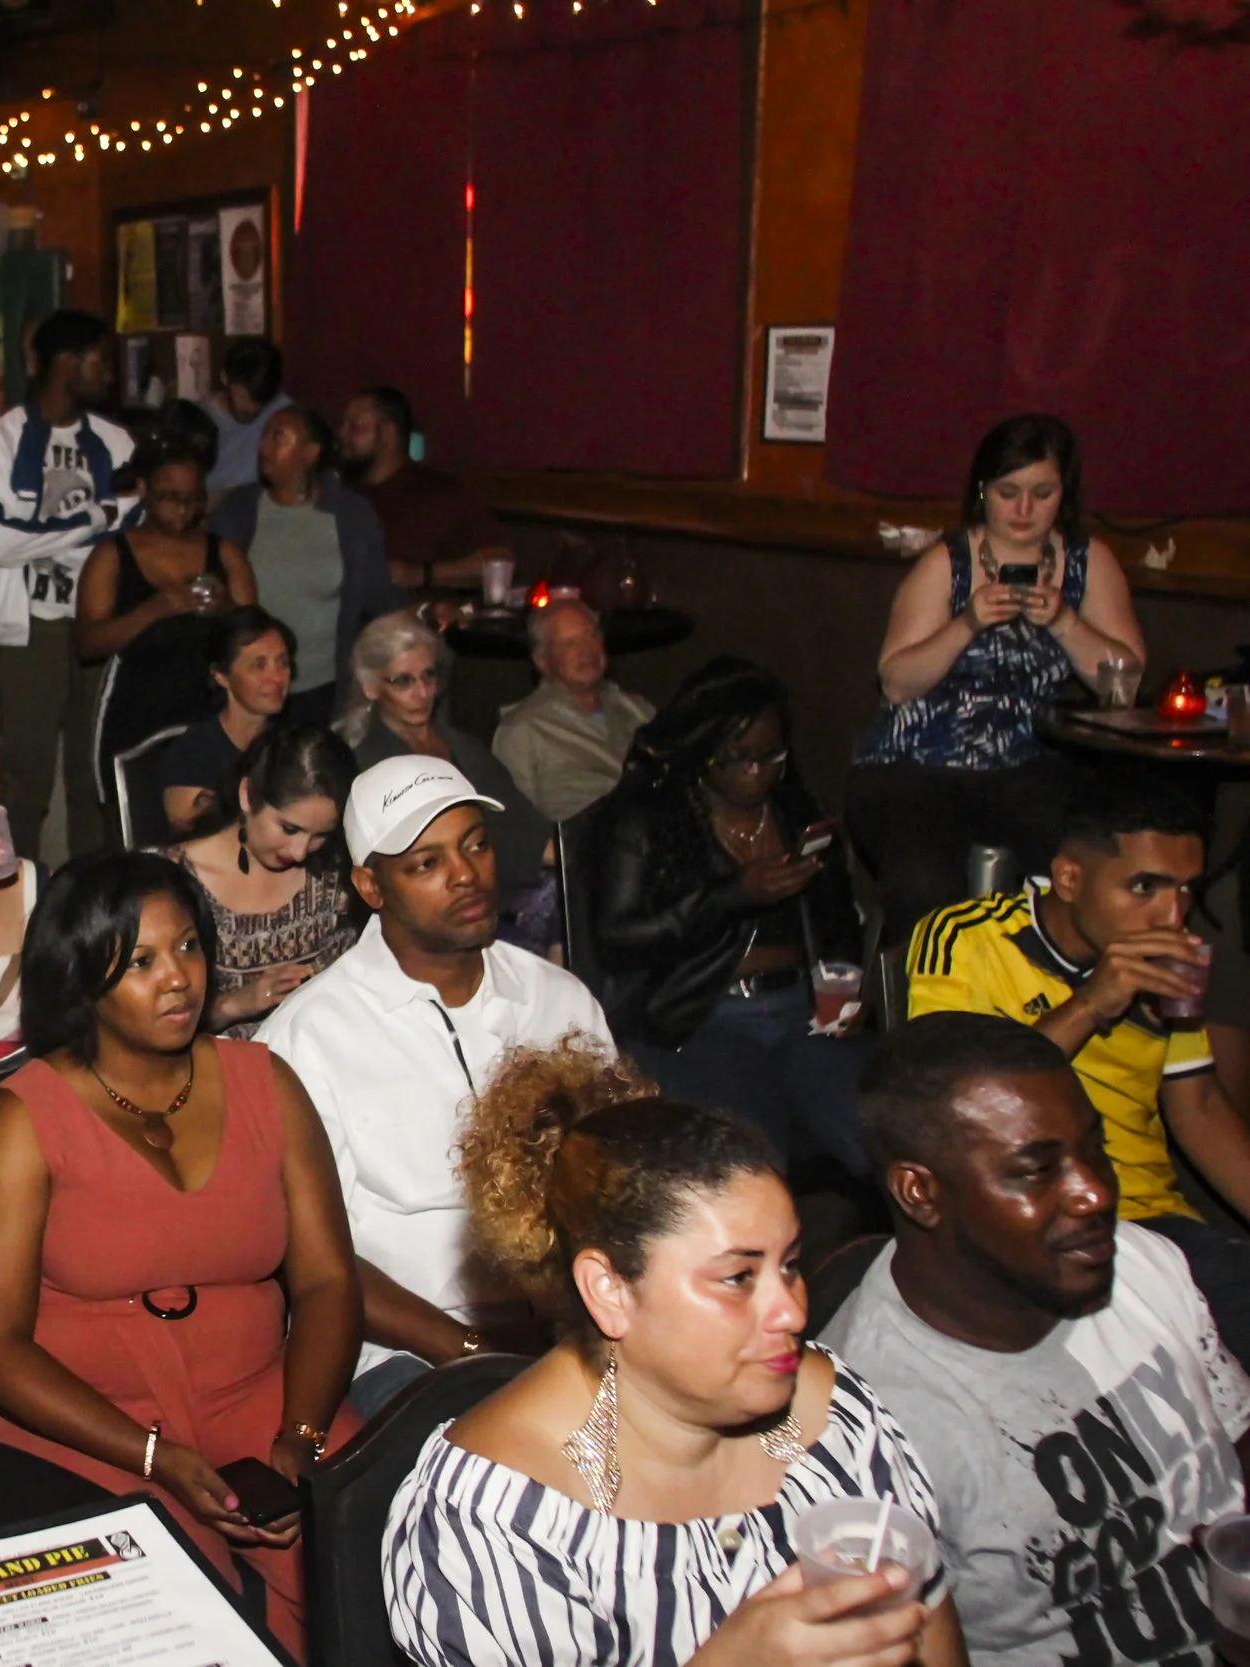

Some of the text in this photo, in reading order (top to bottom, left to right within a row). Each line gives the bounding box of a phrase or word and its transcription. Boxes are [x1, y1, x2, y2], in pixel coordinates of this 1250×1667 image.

[1034, 1344, 1208, 1529] ONLY
[44, 1545, 90, 1566] PIE
[21, 1582, 67, 1599] LOADED
[69, 1573, 105, 1588] FRIES
